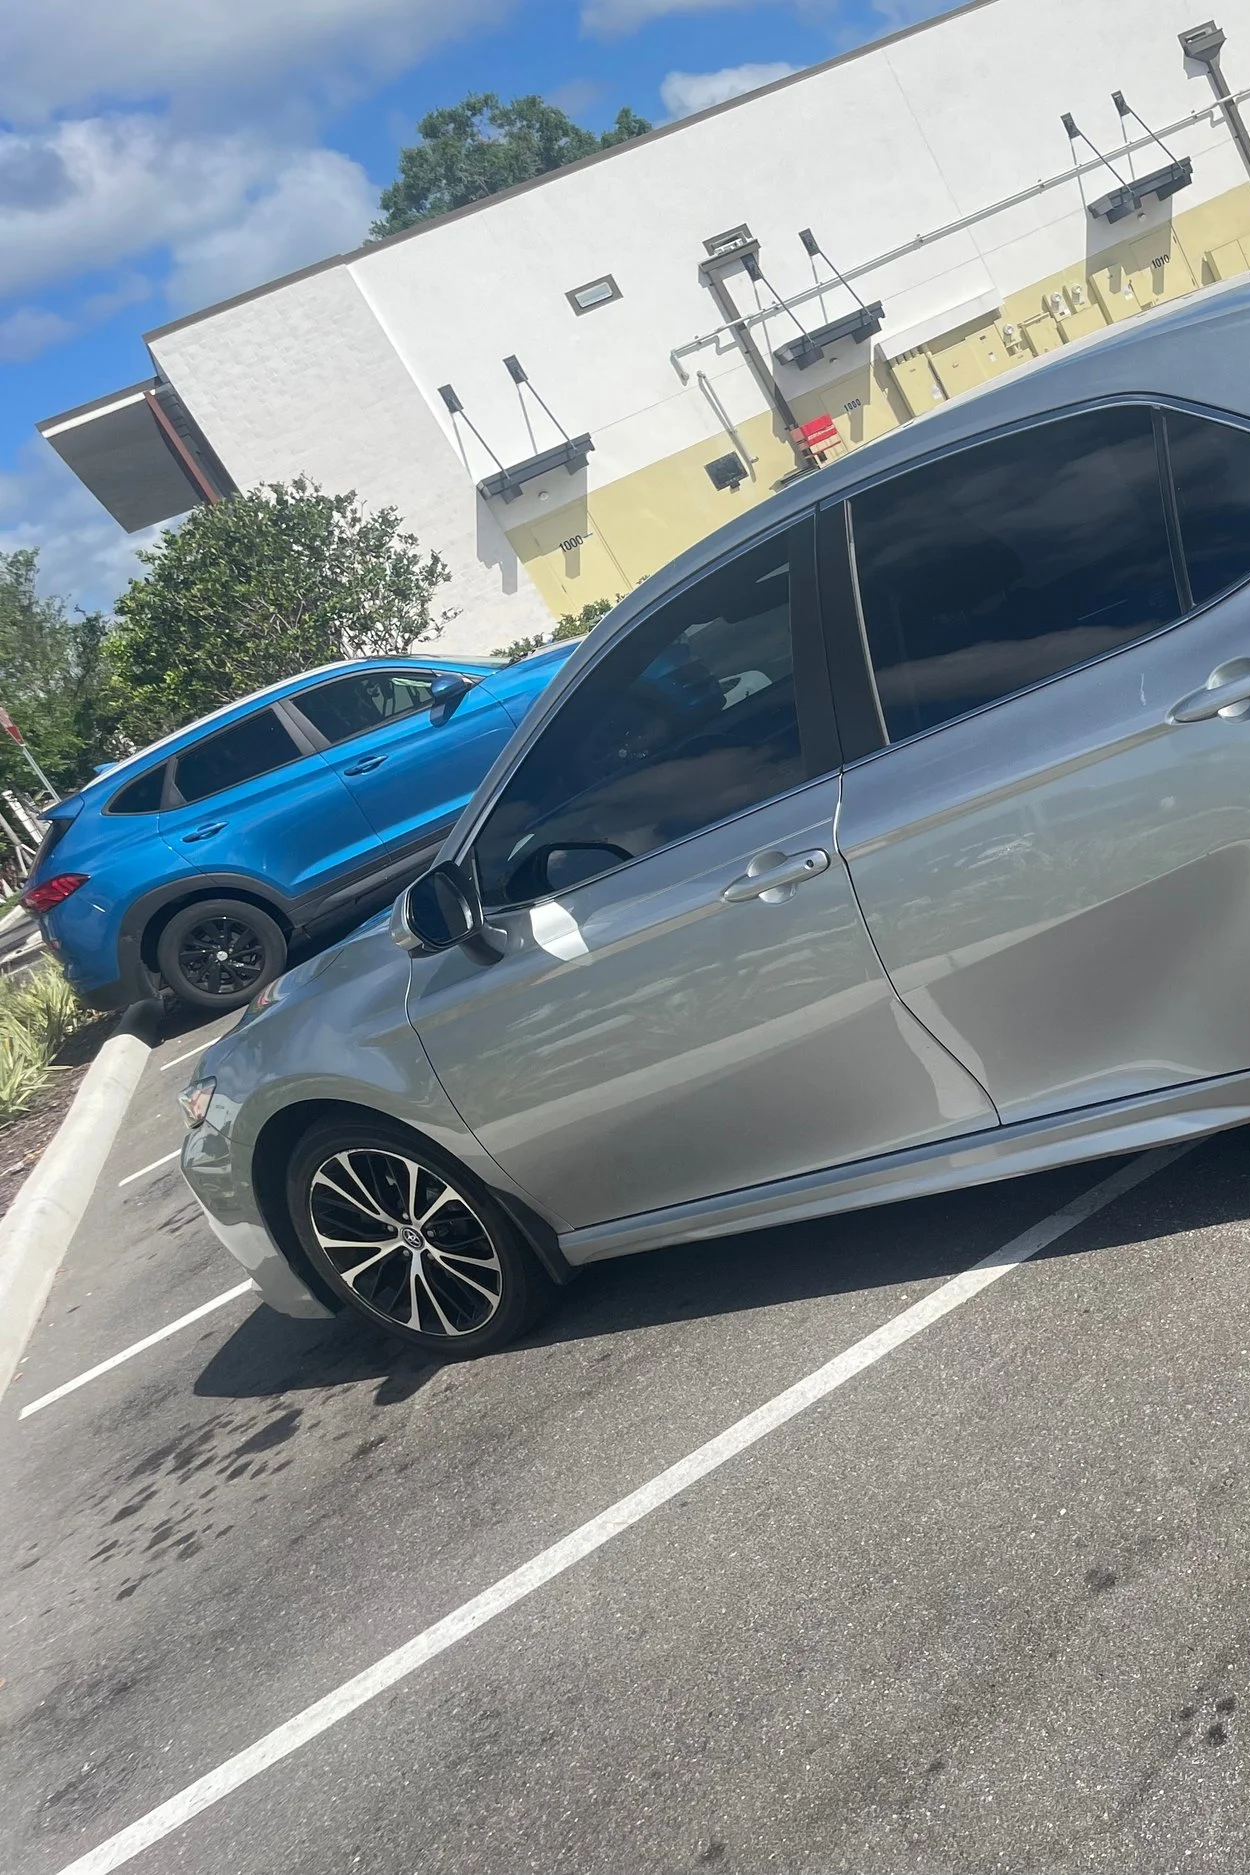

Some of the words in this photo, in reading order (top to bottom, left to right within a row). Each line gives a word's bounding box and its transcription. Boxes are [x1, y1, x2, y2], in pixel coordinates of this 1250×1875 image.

[1152, 254, 1170, 268] 1010
[843, 398, 862, 412] 1000
[559, 534, 584, 552] 1000
